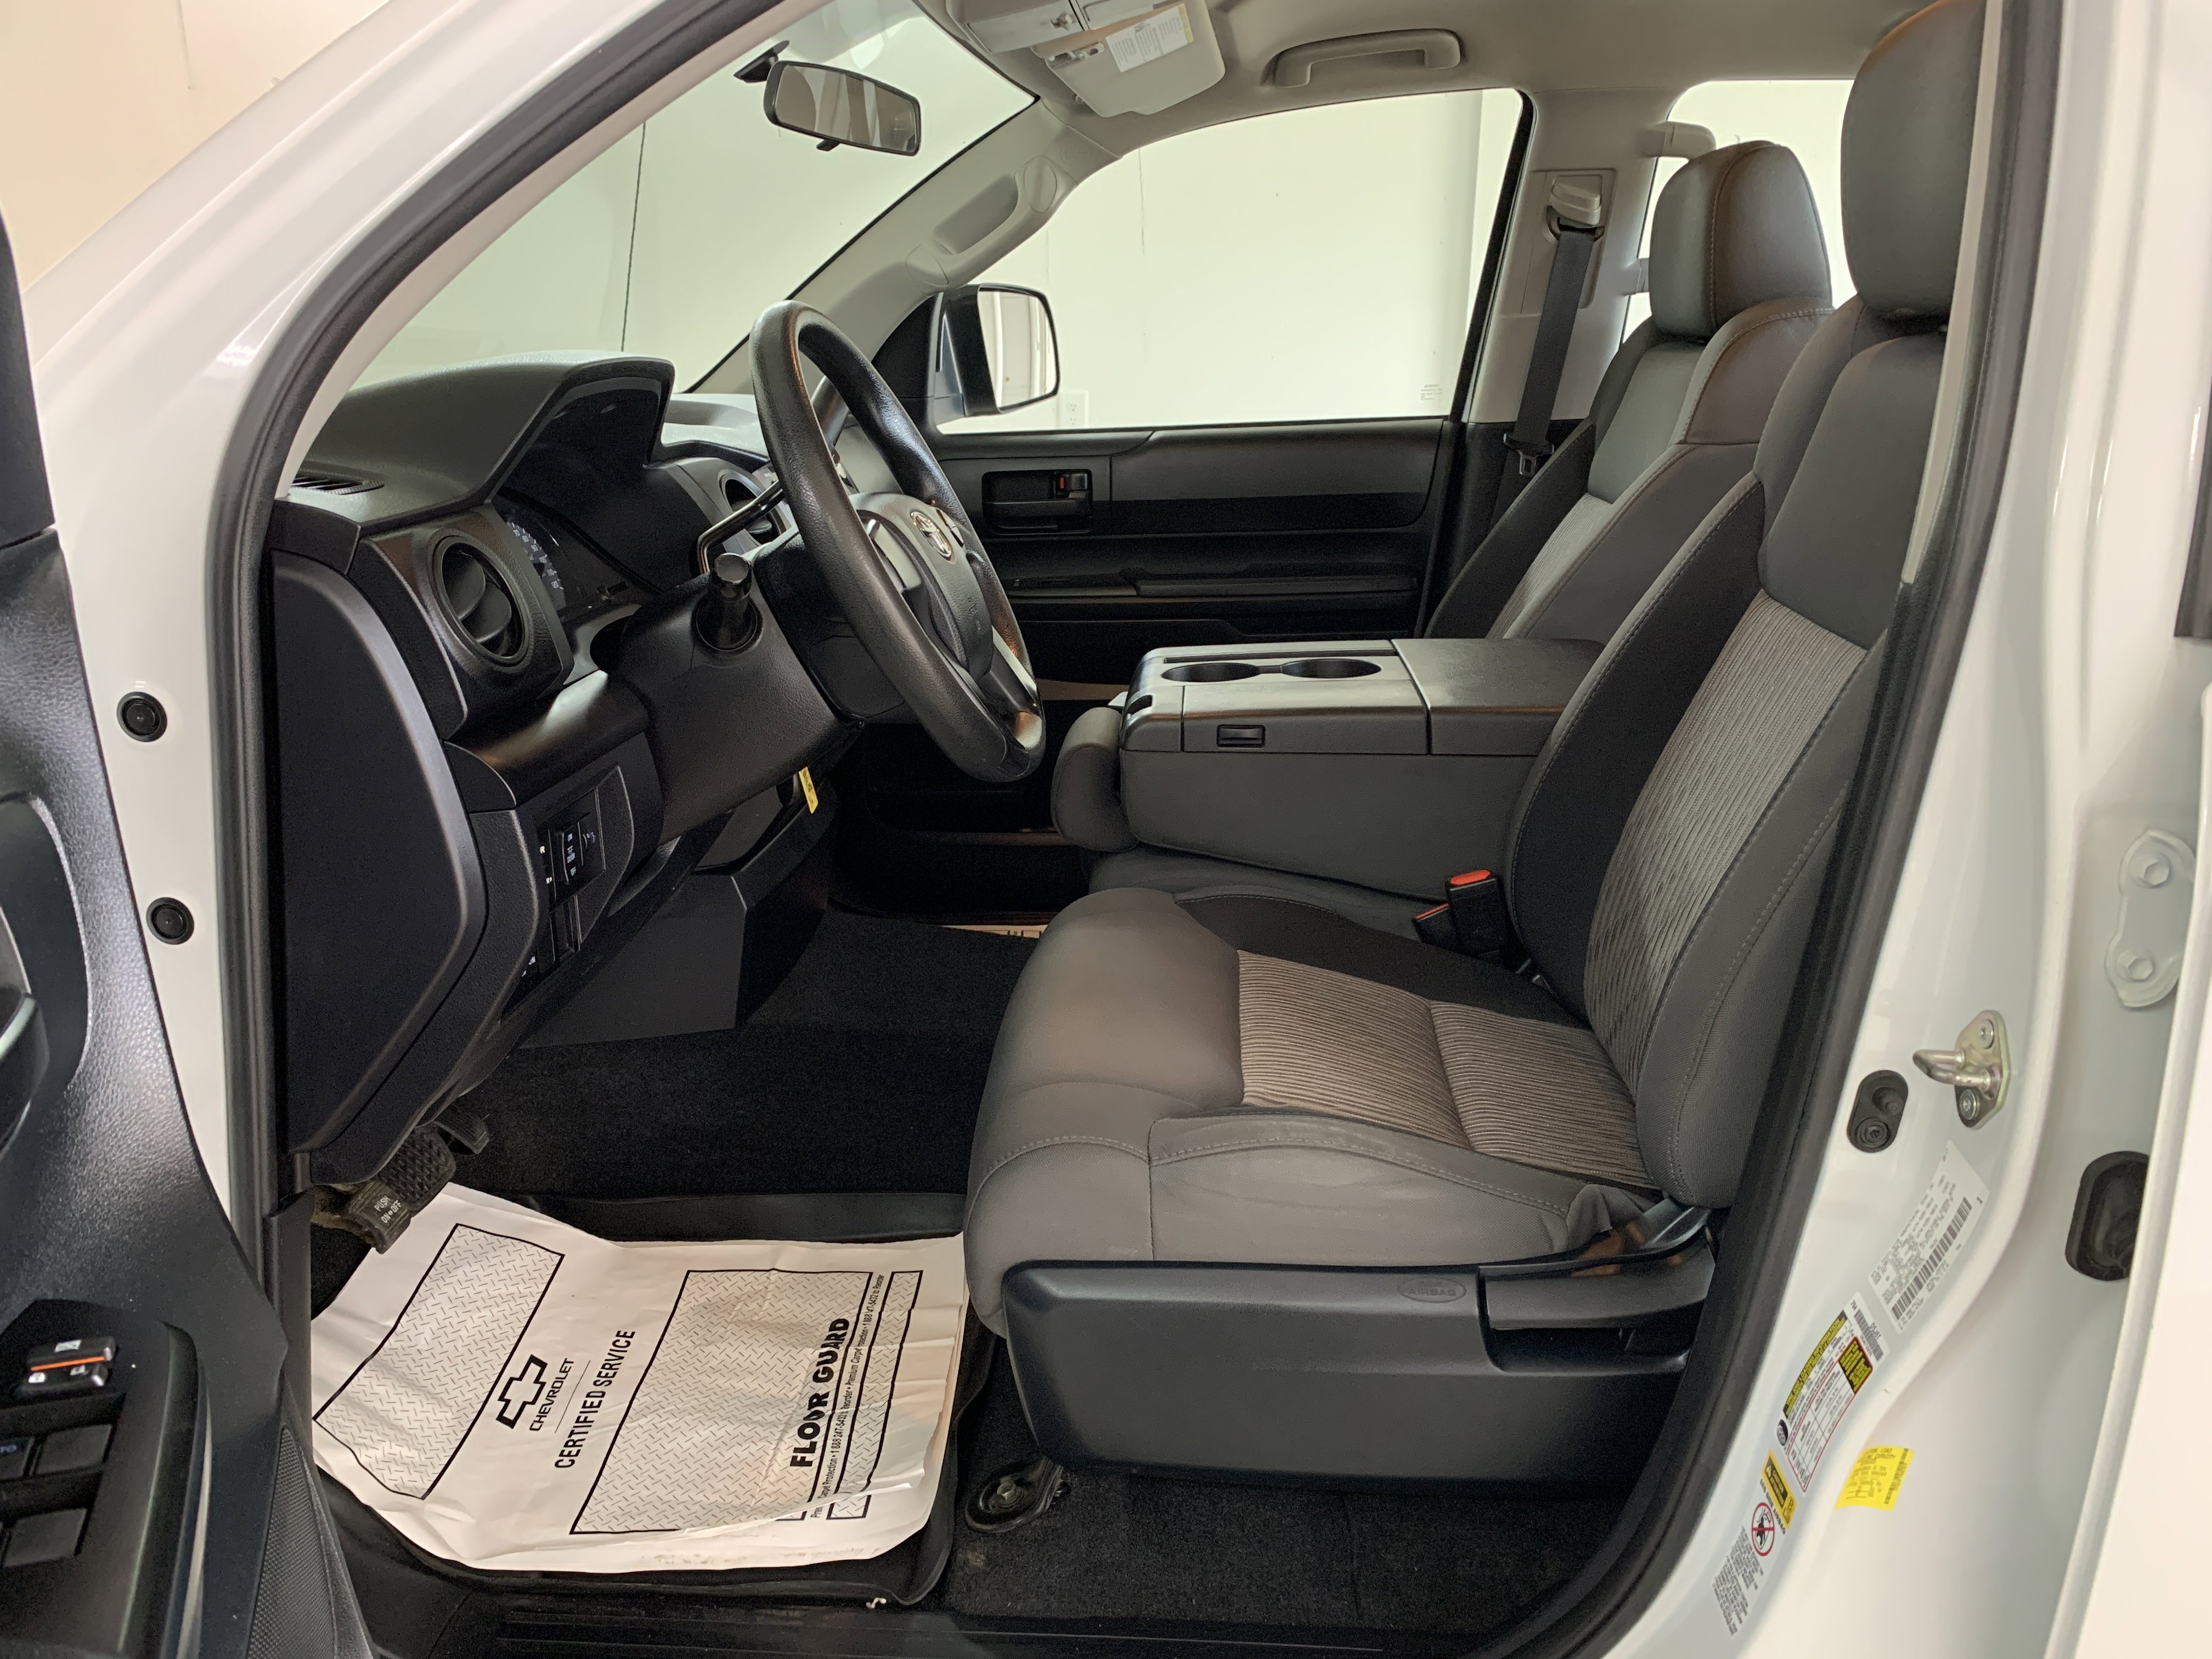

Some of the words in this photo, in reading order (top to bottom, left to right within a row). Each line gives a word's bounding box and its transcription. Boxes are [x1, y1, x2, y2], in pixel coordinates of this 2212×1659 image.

[374, 1195, 391, 1211] PUSH
[529, 1358, 574, 1431] CHEVROLET
[554, 1391, 606, 1468] CERTIFIED
[593, 1330, 636, 1386] SERVICE
[790, 1391, 830, 1466] FLOOR
[812, 1318, 849, 1383] GUARD
[822, 1458, 838, 1485] Protection
[831, 1438, 842, 1449] 888
